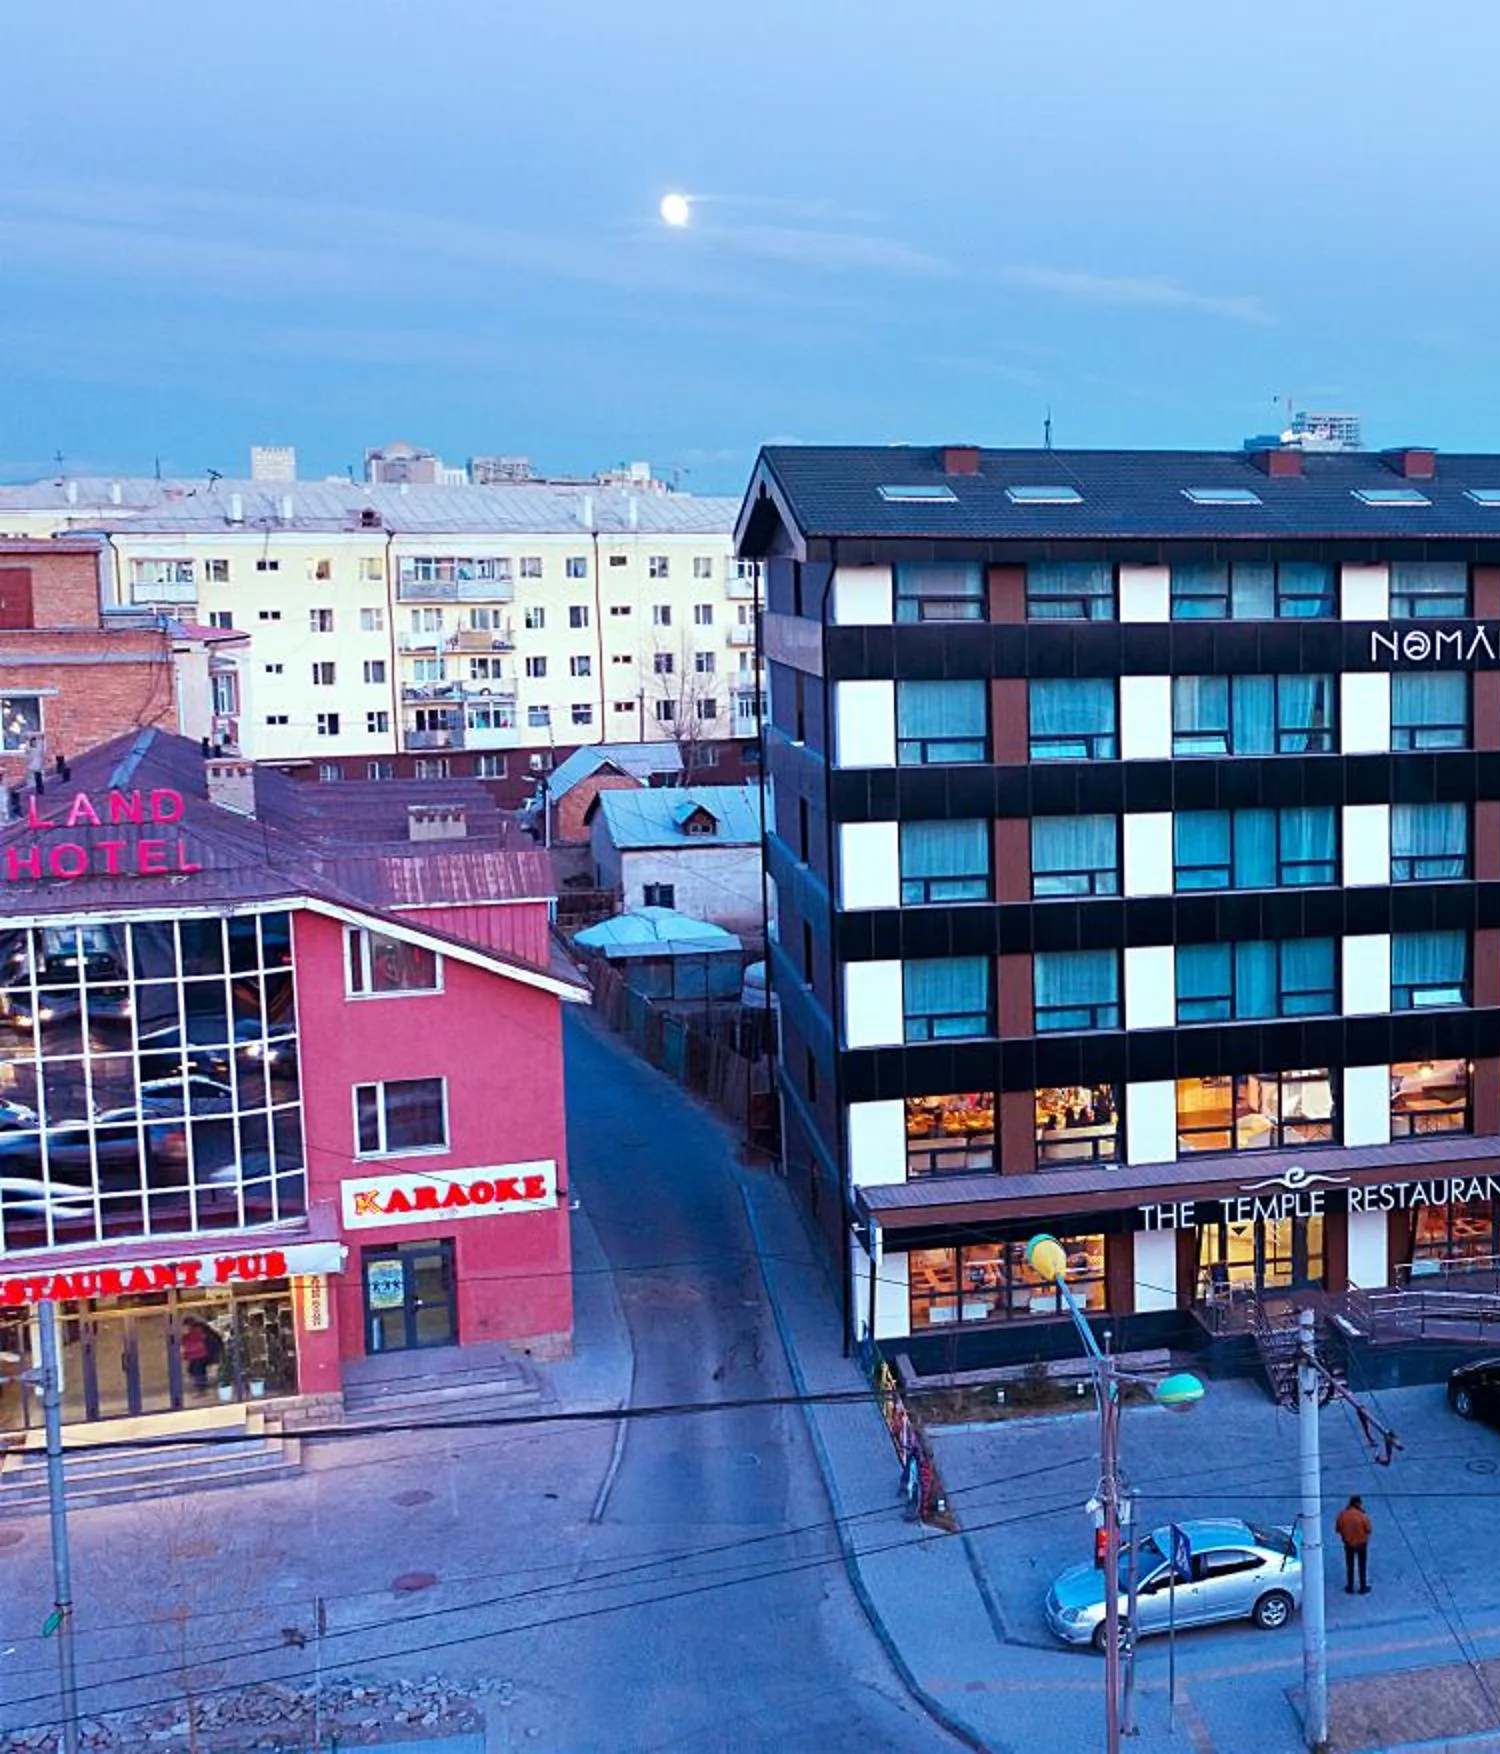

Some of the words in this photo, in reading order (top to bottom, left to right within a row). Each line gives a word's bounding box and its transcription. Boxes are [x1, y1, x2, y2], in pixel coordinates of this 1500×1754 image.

[27, 788, 187, 830] LAND
[6, 838, 203, 881] HOTEL
[354, 1174, 547, 1216] KARAOKE
[1138, 1201, 1196, 1231] THE
[1219, 1190, 1326, 1224] TEMPLE
[213, 1251, 288, 1285] PUB
